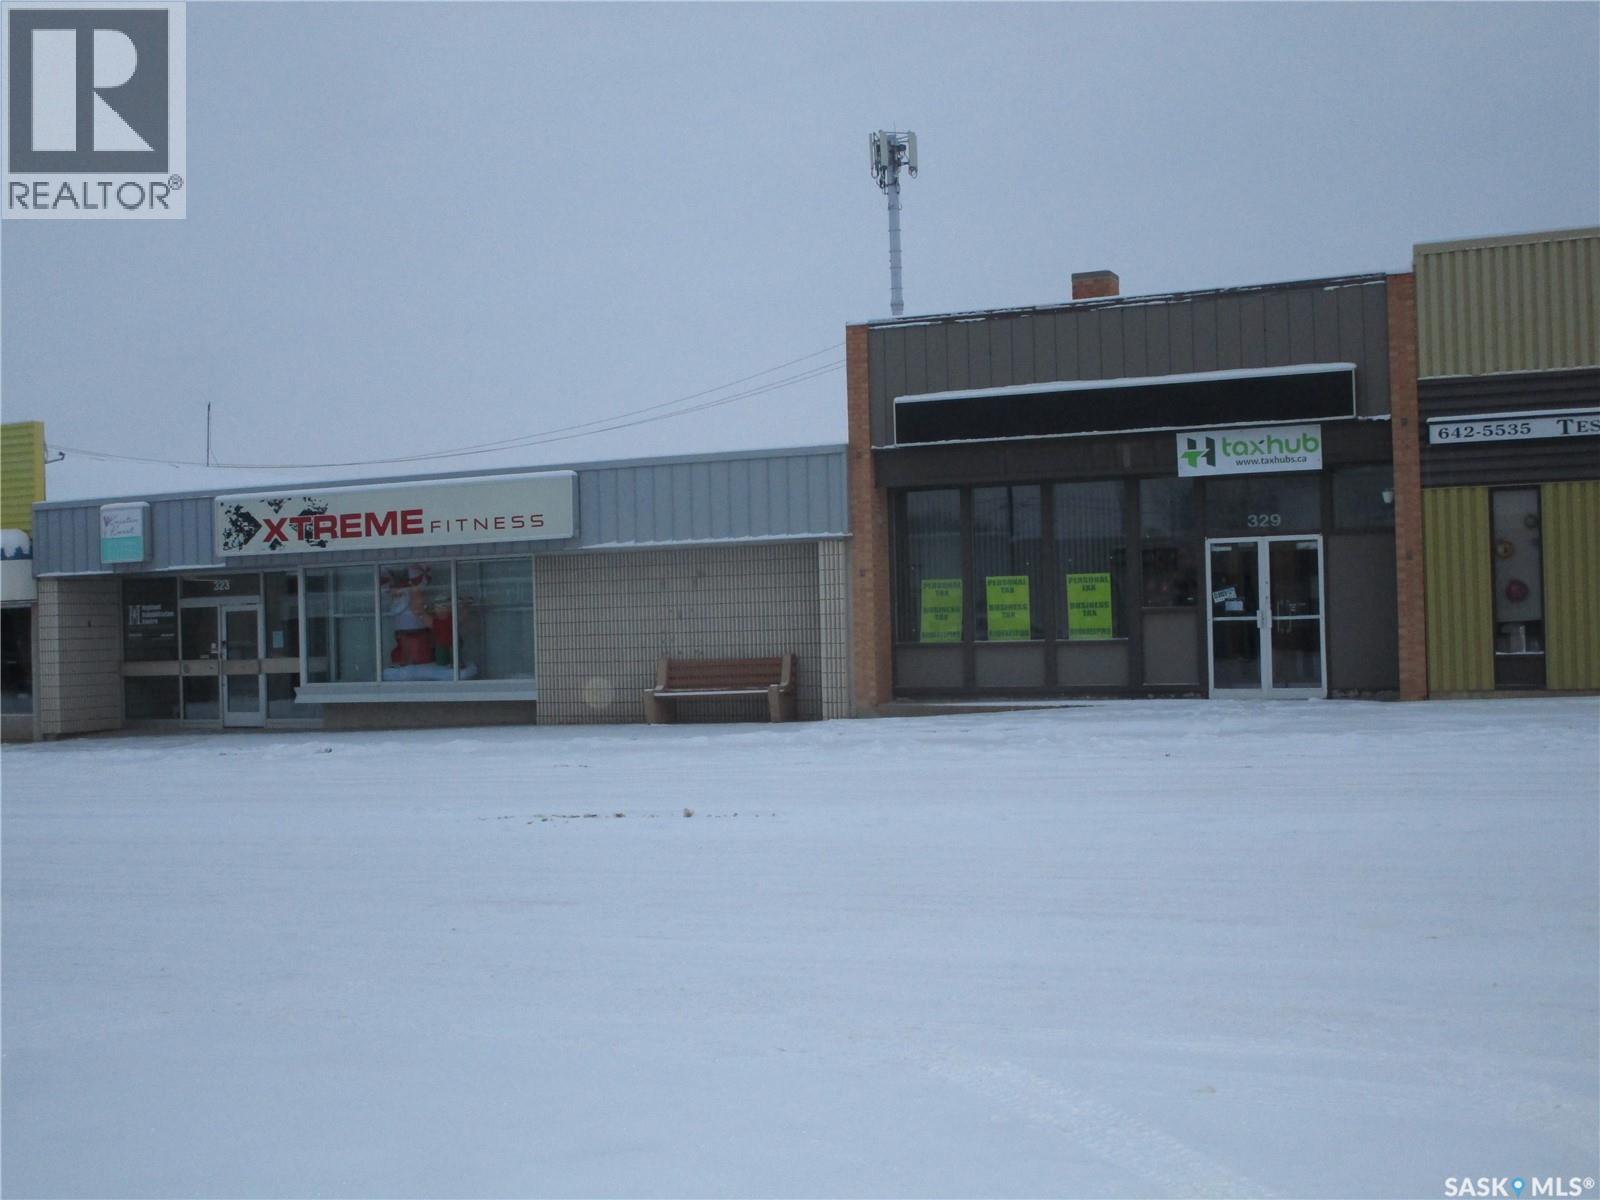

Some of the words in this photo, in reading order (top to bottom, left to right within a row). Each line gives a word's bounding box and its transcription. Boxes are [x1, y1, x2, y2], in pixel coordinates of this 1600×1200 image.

[1438, 422, 1532, 440] 642-5535
[1556, 418, 1600, 435] TES
[1221, 432, 1320, 457] taxhub
[1235, 455, 1308, 467] www.taxhubs.ca
[262, 508, 424, 543] XTREME
[430, 514, 545, 534] FITNESS
[1247, 513, 1282, 527] 329
[213, 579, 231, 591] 323
